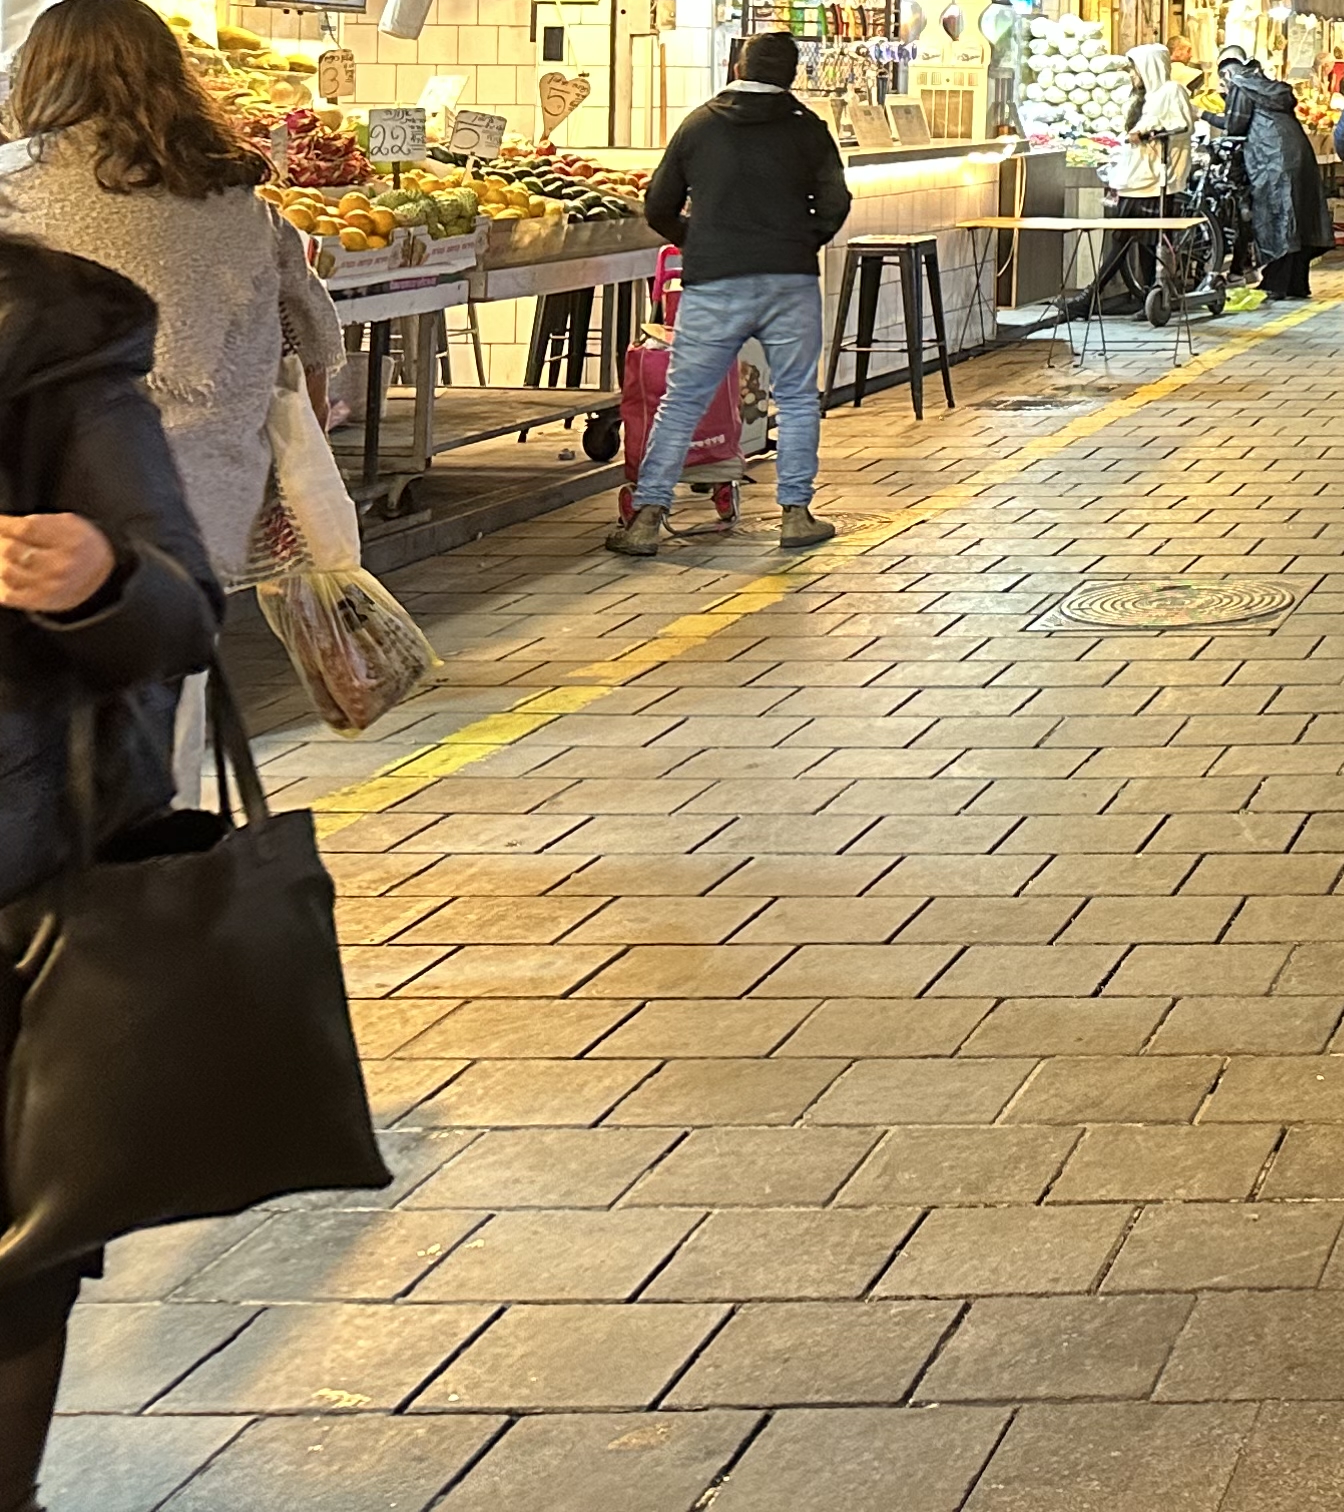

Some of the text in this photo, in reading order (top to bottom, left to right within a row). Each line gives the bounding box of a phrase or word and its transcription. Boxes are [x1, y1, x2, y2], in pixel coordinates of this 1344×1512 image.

[322, 66, 340, 95] 3
[543, 87, 571, 117] 5
[370, 124, 412, 156] 22
[453, 120, 484, 150] 5
